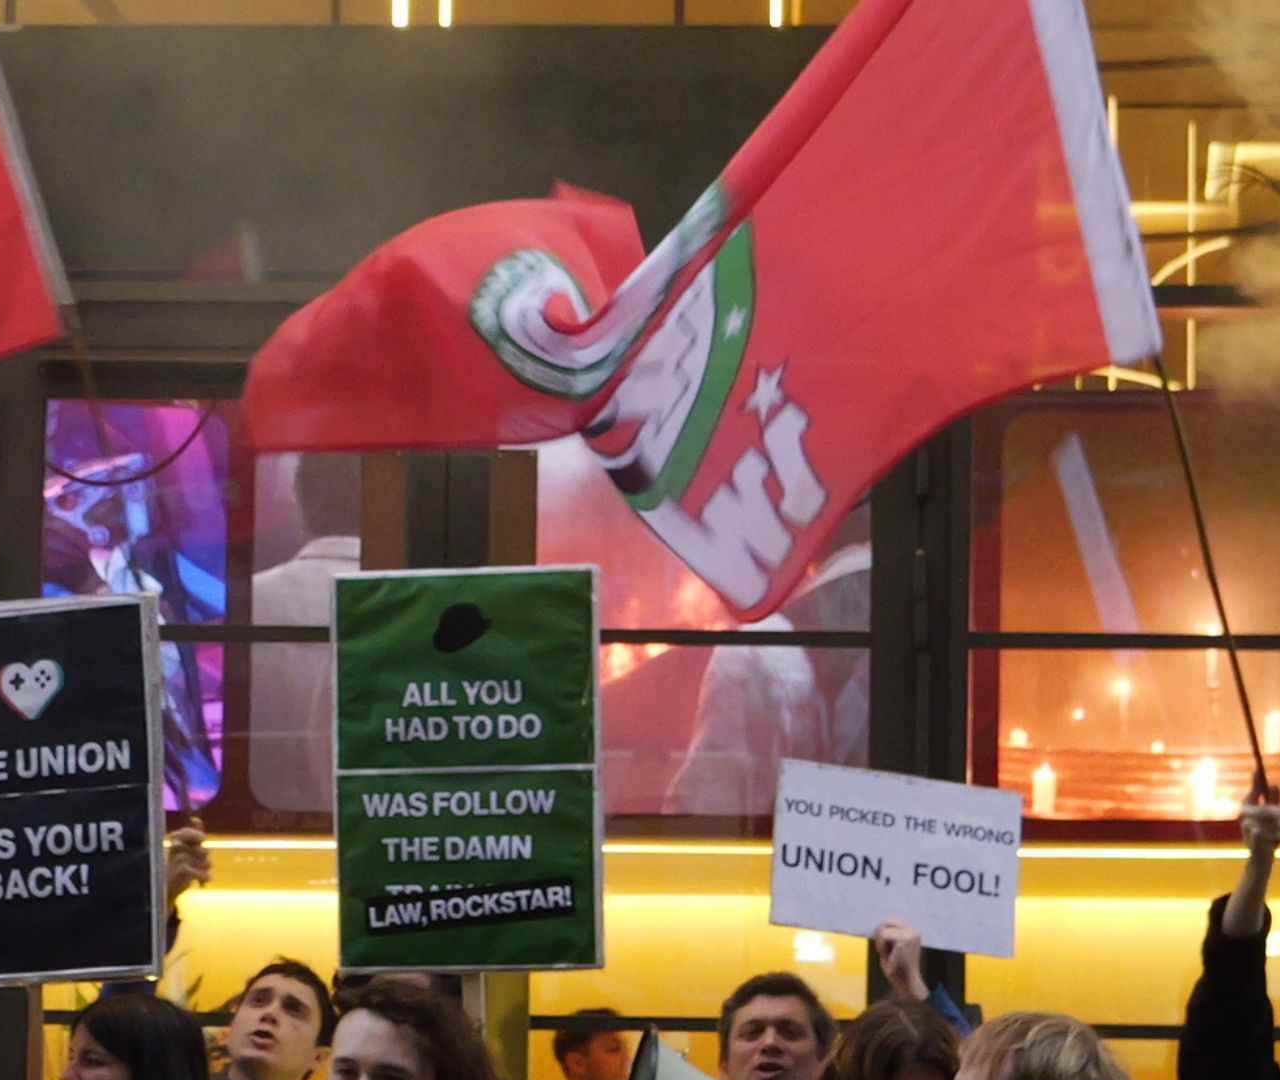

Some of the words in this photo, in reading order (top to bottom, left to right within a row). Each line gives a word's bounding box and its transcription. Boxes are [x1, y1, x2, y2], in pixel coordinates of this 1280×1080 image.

[402, 681, 456, 707] ALL
[462, 680, 522, 706] YOU
[385, 717, 448, 742] HAD
[451, 715, 492, 740] TO
[498, 713, 542, 739] DO
[16, 740, 130, 778] UNION
[362, 792, 428, 817] WAS
[433, 789, 555, 816] FOLLOW
[24, 821, 123, 856] YOUR
[784, 798, 822, 818] YOU
[829, 805, 896, 829] PICKED
[904, 815, 937, 835] THE
[943, 822, 1015, 846] WRONG
[381, 836, 440, 861] THE
[445, 835, 532, 860] DAMN
[782, 843, 890, 885] UNION,
[913, 863, 1001, 897] FOOL!
[369, 904, 428, 927] LAW,
[430, 885, 572, 920] ROCKSTAR!
